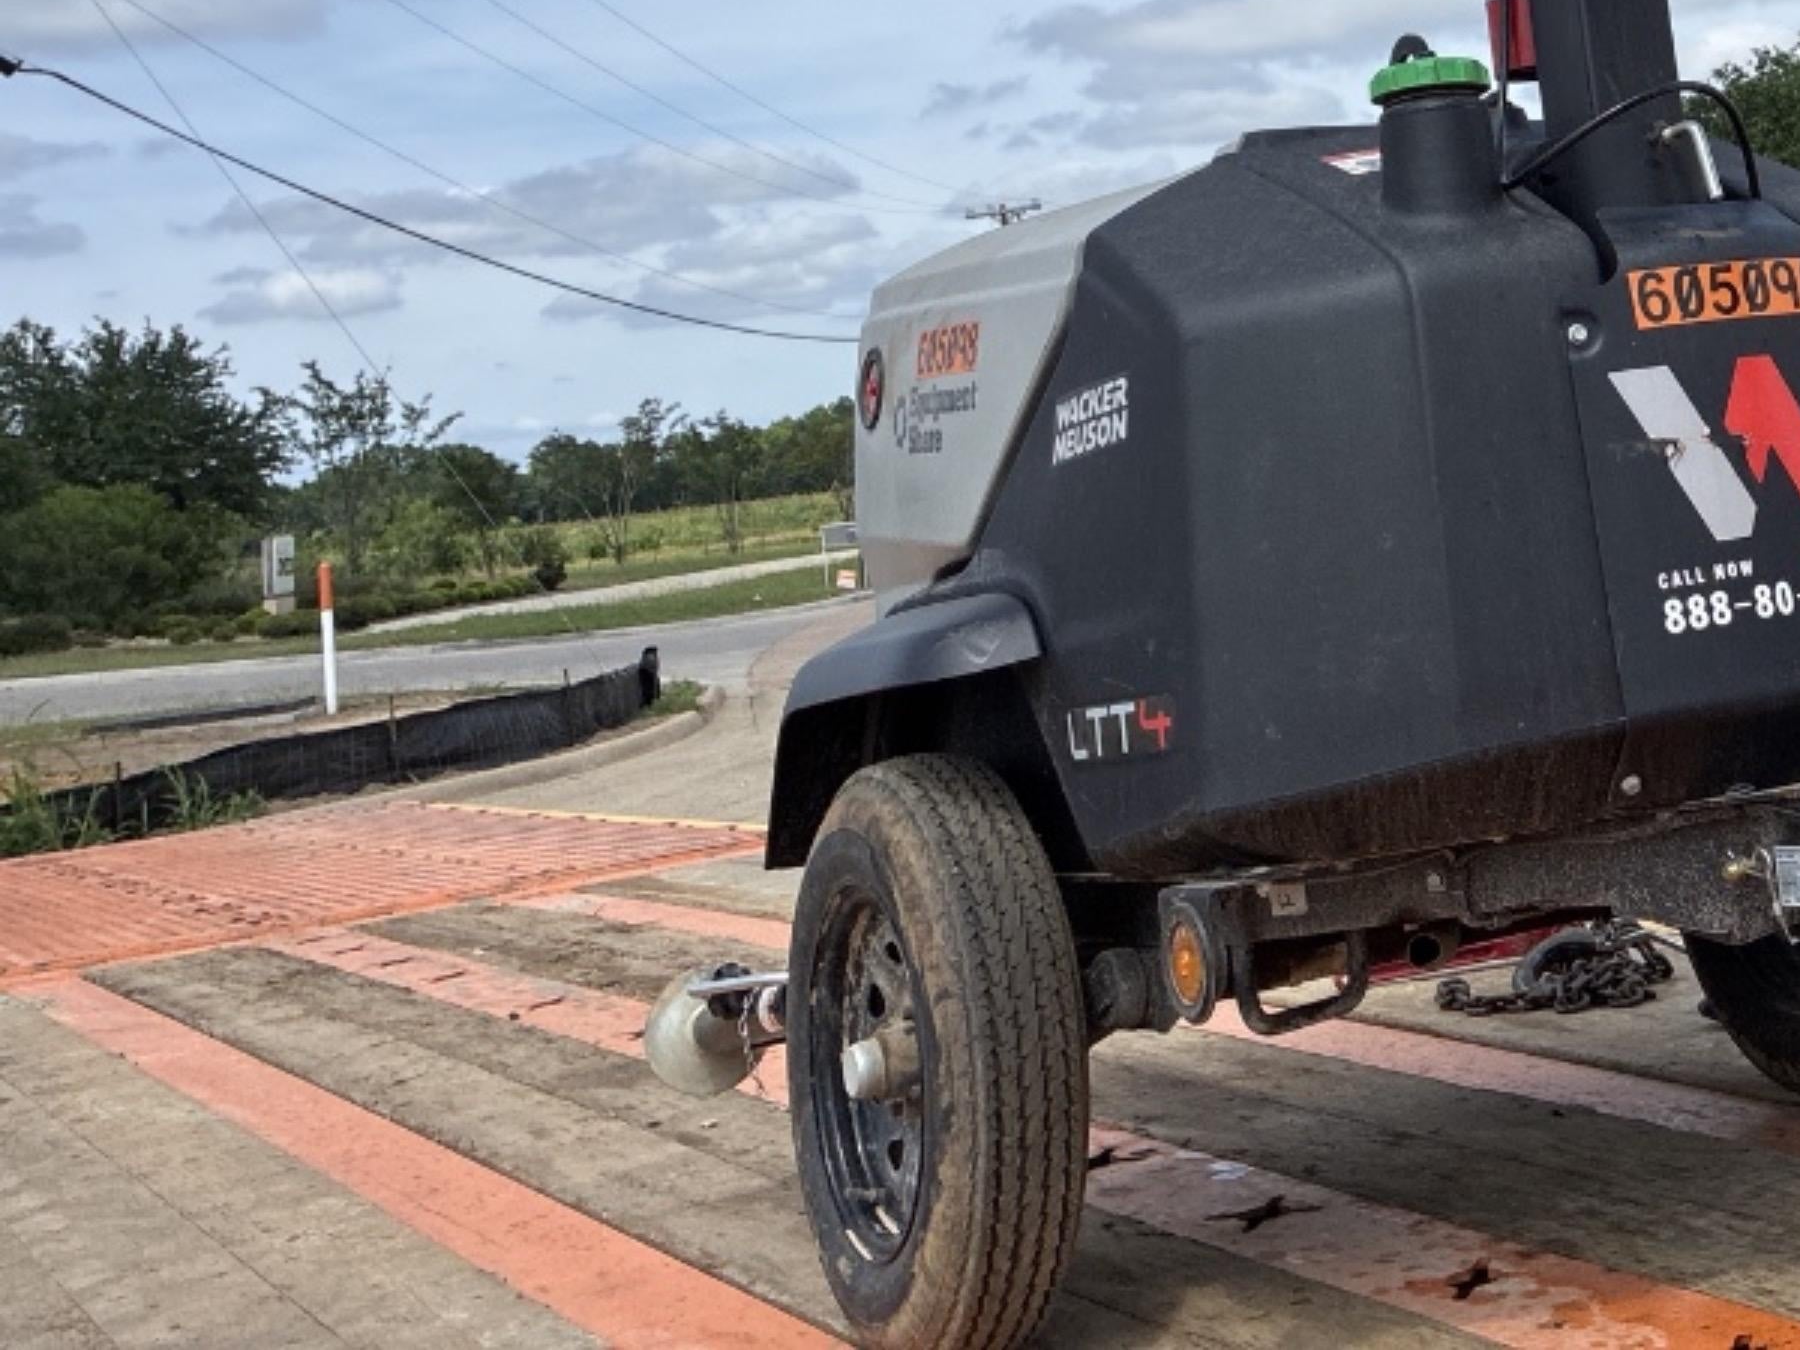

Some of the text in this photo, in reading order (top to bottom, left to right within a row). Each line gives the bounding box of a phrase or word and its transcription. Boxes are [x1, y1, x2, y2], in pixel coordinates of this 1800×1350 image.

[1055, 377, 1129, 431] WACKER
[1052, 410, 1130, 466] NEUSON
[1658, 559, 1754, 590] CALL NOW
[1066, 698, 1172, 760] LTT4
